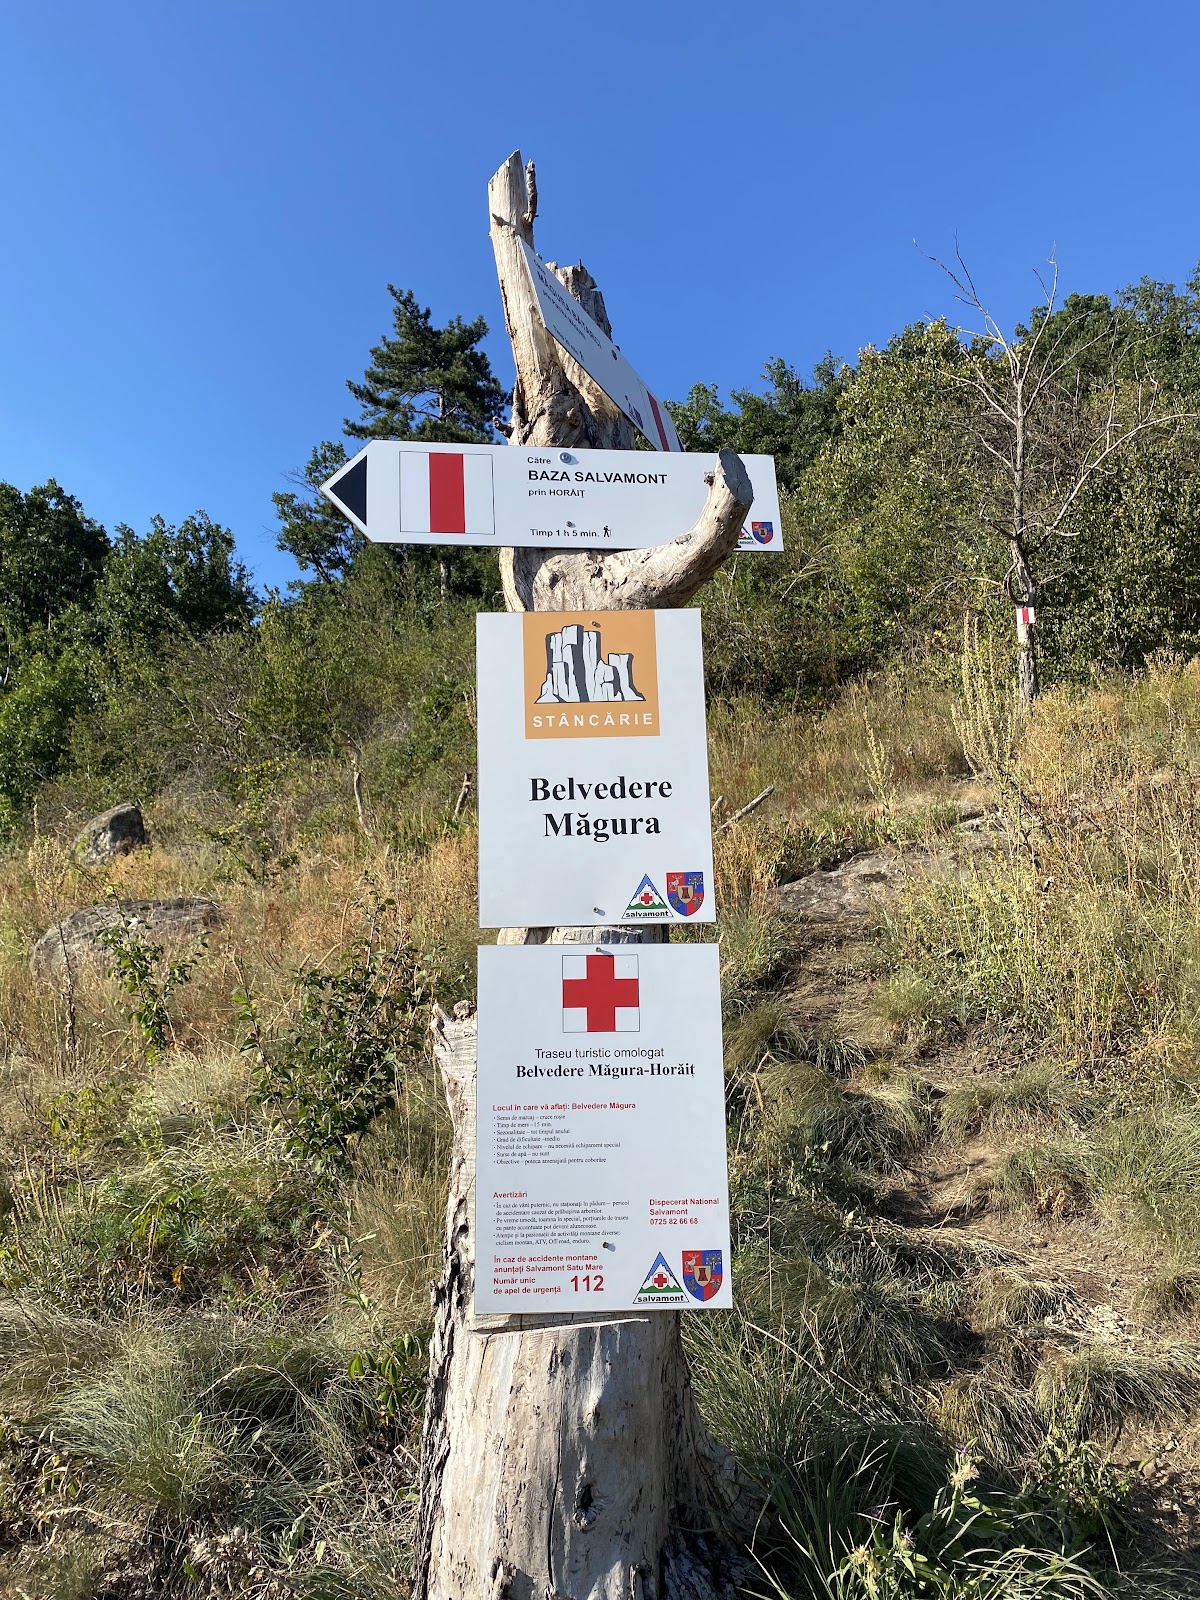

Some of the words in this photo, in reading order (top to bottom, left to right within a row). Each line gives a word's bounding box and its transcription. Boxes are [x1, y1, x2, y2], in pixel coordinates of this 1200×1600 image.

[527, 456, 551, 464] Către
[528, 470, 571, 482] BAZA
[575, 472, 667, 484] SALVAMONT
[528, 489, 547, 497] prin
[530, 529, 553, 538] Timp
[581, 529, 600, 538] min.
[532, 711, 653, 728] STÂNCĂRIE
[529, 776, 673, 802] Belvedere
[544, 812, 661, 843] Măgura
[625, 910, 669, 919] salvamont
[535, 1048, 572, 1059] Traseu
[575, 1047, 611, 1058] turistic
[614, 1047, 665, 1060] omologat
[516, 1064, 584, 1078] Belvedere
[588, 1062, 696, 1079] Măgura-Horăiț
[492, 1104, 513, 1112] Locul
[571, 1102, 607, 1110] Belvedere
[609, 1102, 636, 1111] Măgura
[493, 1191, 528, 1199] Avertizări
[649, 1198, 688, 1207] Dispecerat
[493, 1255, 500, 1263] În
[517, 1255, 527, 1263] de
[493, 1265, 524, 1274] anunțați
[525, 1264, 565, 1272] Salvamont
[585, 1263, 603, 1271] Mare
[493, 1277, 518, 1285] Număr
[570, 1275, 604, 1292] 112
[493, 1287, 503, 1295] de
[504, 1287, 520, 1295] apel
[521, 1286, 531, 1294] de
[533, 1286, 561, 1295] urgență
[637, 1295, 684, 1303] salvamont
